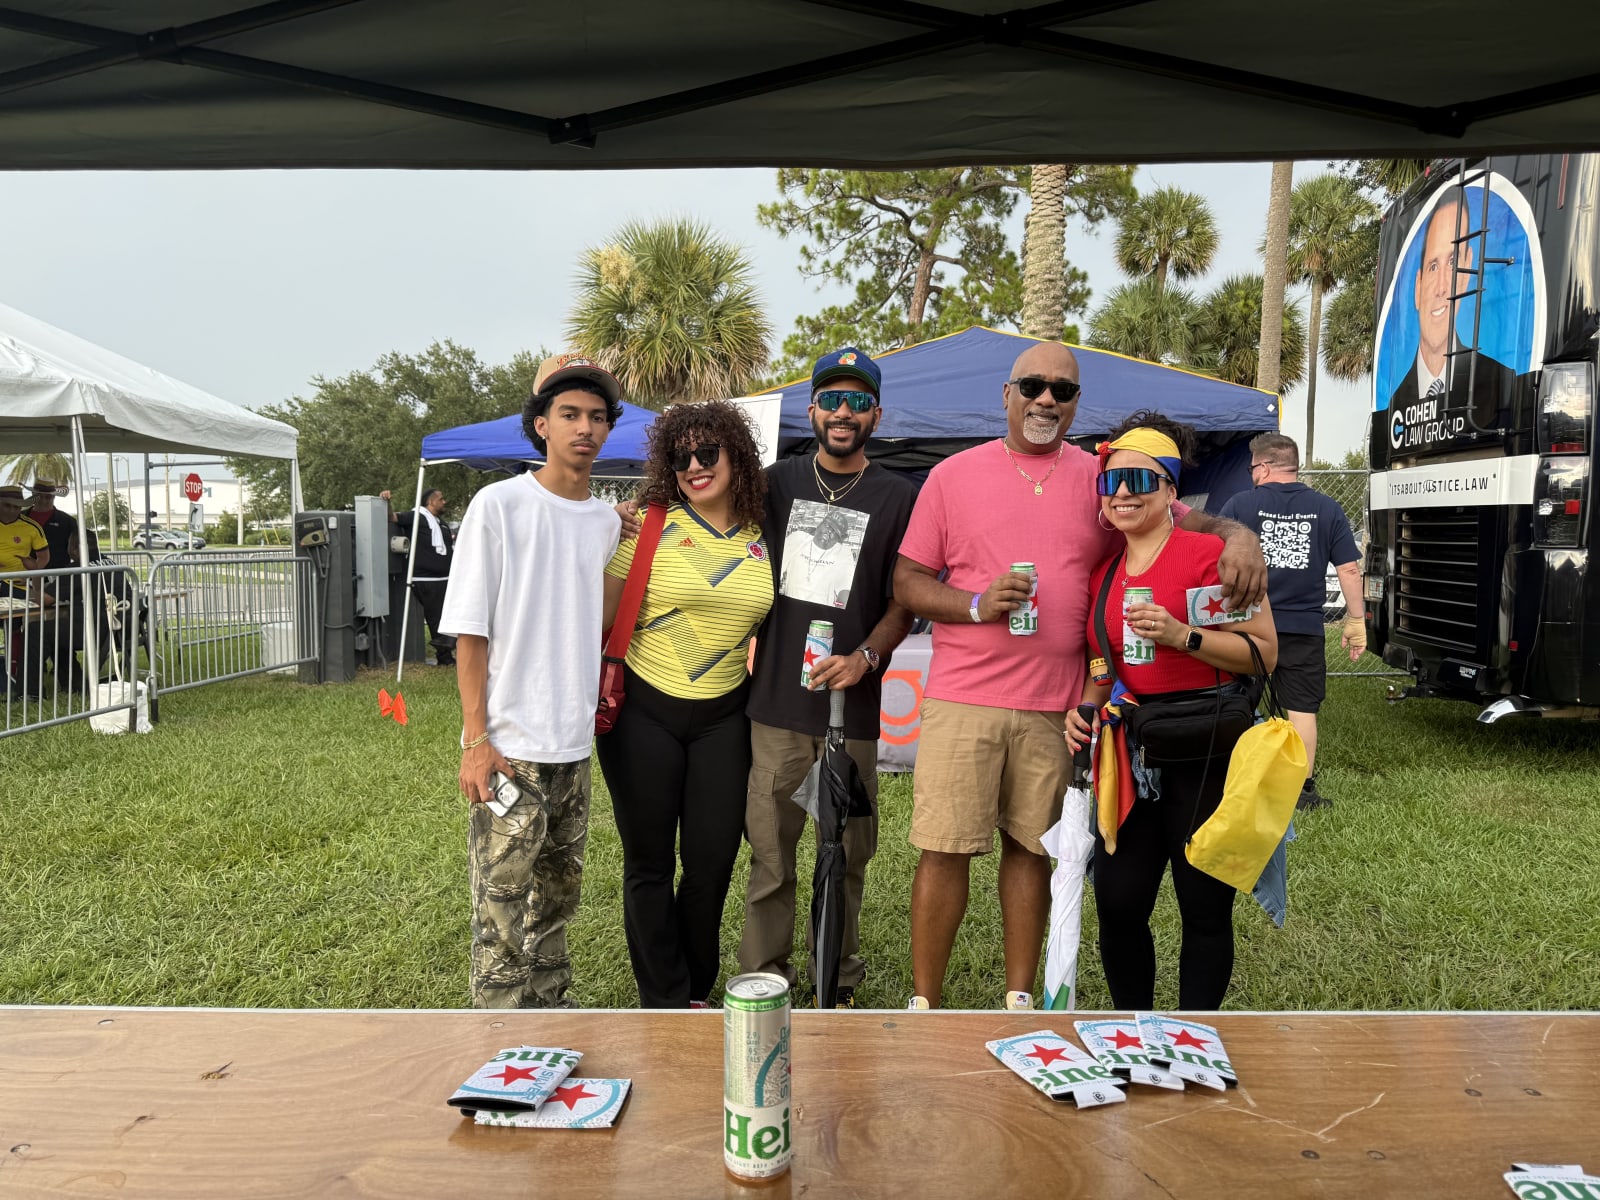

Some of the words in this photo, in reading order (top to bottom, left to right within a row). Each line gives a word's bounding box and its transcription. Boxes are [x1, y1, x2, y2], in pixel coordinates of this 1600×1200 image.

[1405, 400, 1437, 425] COHEN
[1405, 425, 1423, 447] LAW
[1425, 417, 1464, 443] GROUP
[185, 481, 202, 494] STOP
[780, 1026, 789, 1099] SILVER
[997, 1040, 1035, 1067] SILVER
[524, 1070, 553, 1100] SILVER
[725, 1106, 790, 1160] Hei
